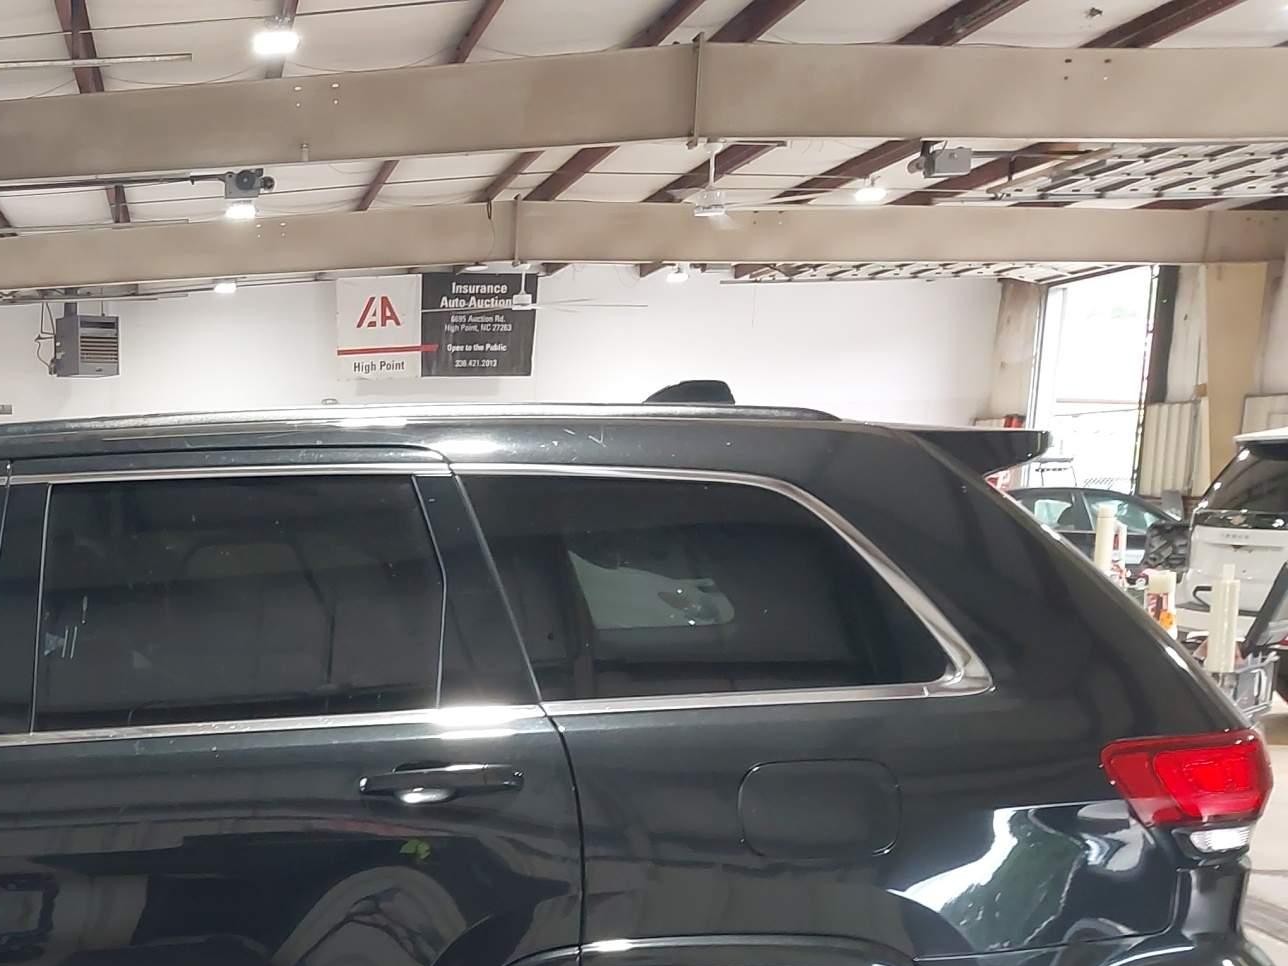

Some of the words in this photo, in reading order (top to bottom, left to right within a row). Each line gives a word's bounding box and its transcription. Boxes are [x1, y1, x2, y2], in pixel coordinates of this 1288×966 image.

[452, 282, 508, 294] Insurance
[440, 296, 466, 308] Auto
[468, 295, 513, 309] Auction
[356, 296, 401, 328] IAA
[467, 315, 494, 323] Auction
[444, 324, 460, 333] High
[460, 324, 480, 332] Point,
[447, 343, 465, 353] Open
[473, 343, 485, 351] the
[485, 343, 508, 351] Public
[353, 361, 377, 374] High
[379, 360, 406, 371] Point
